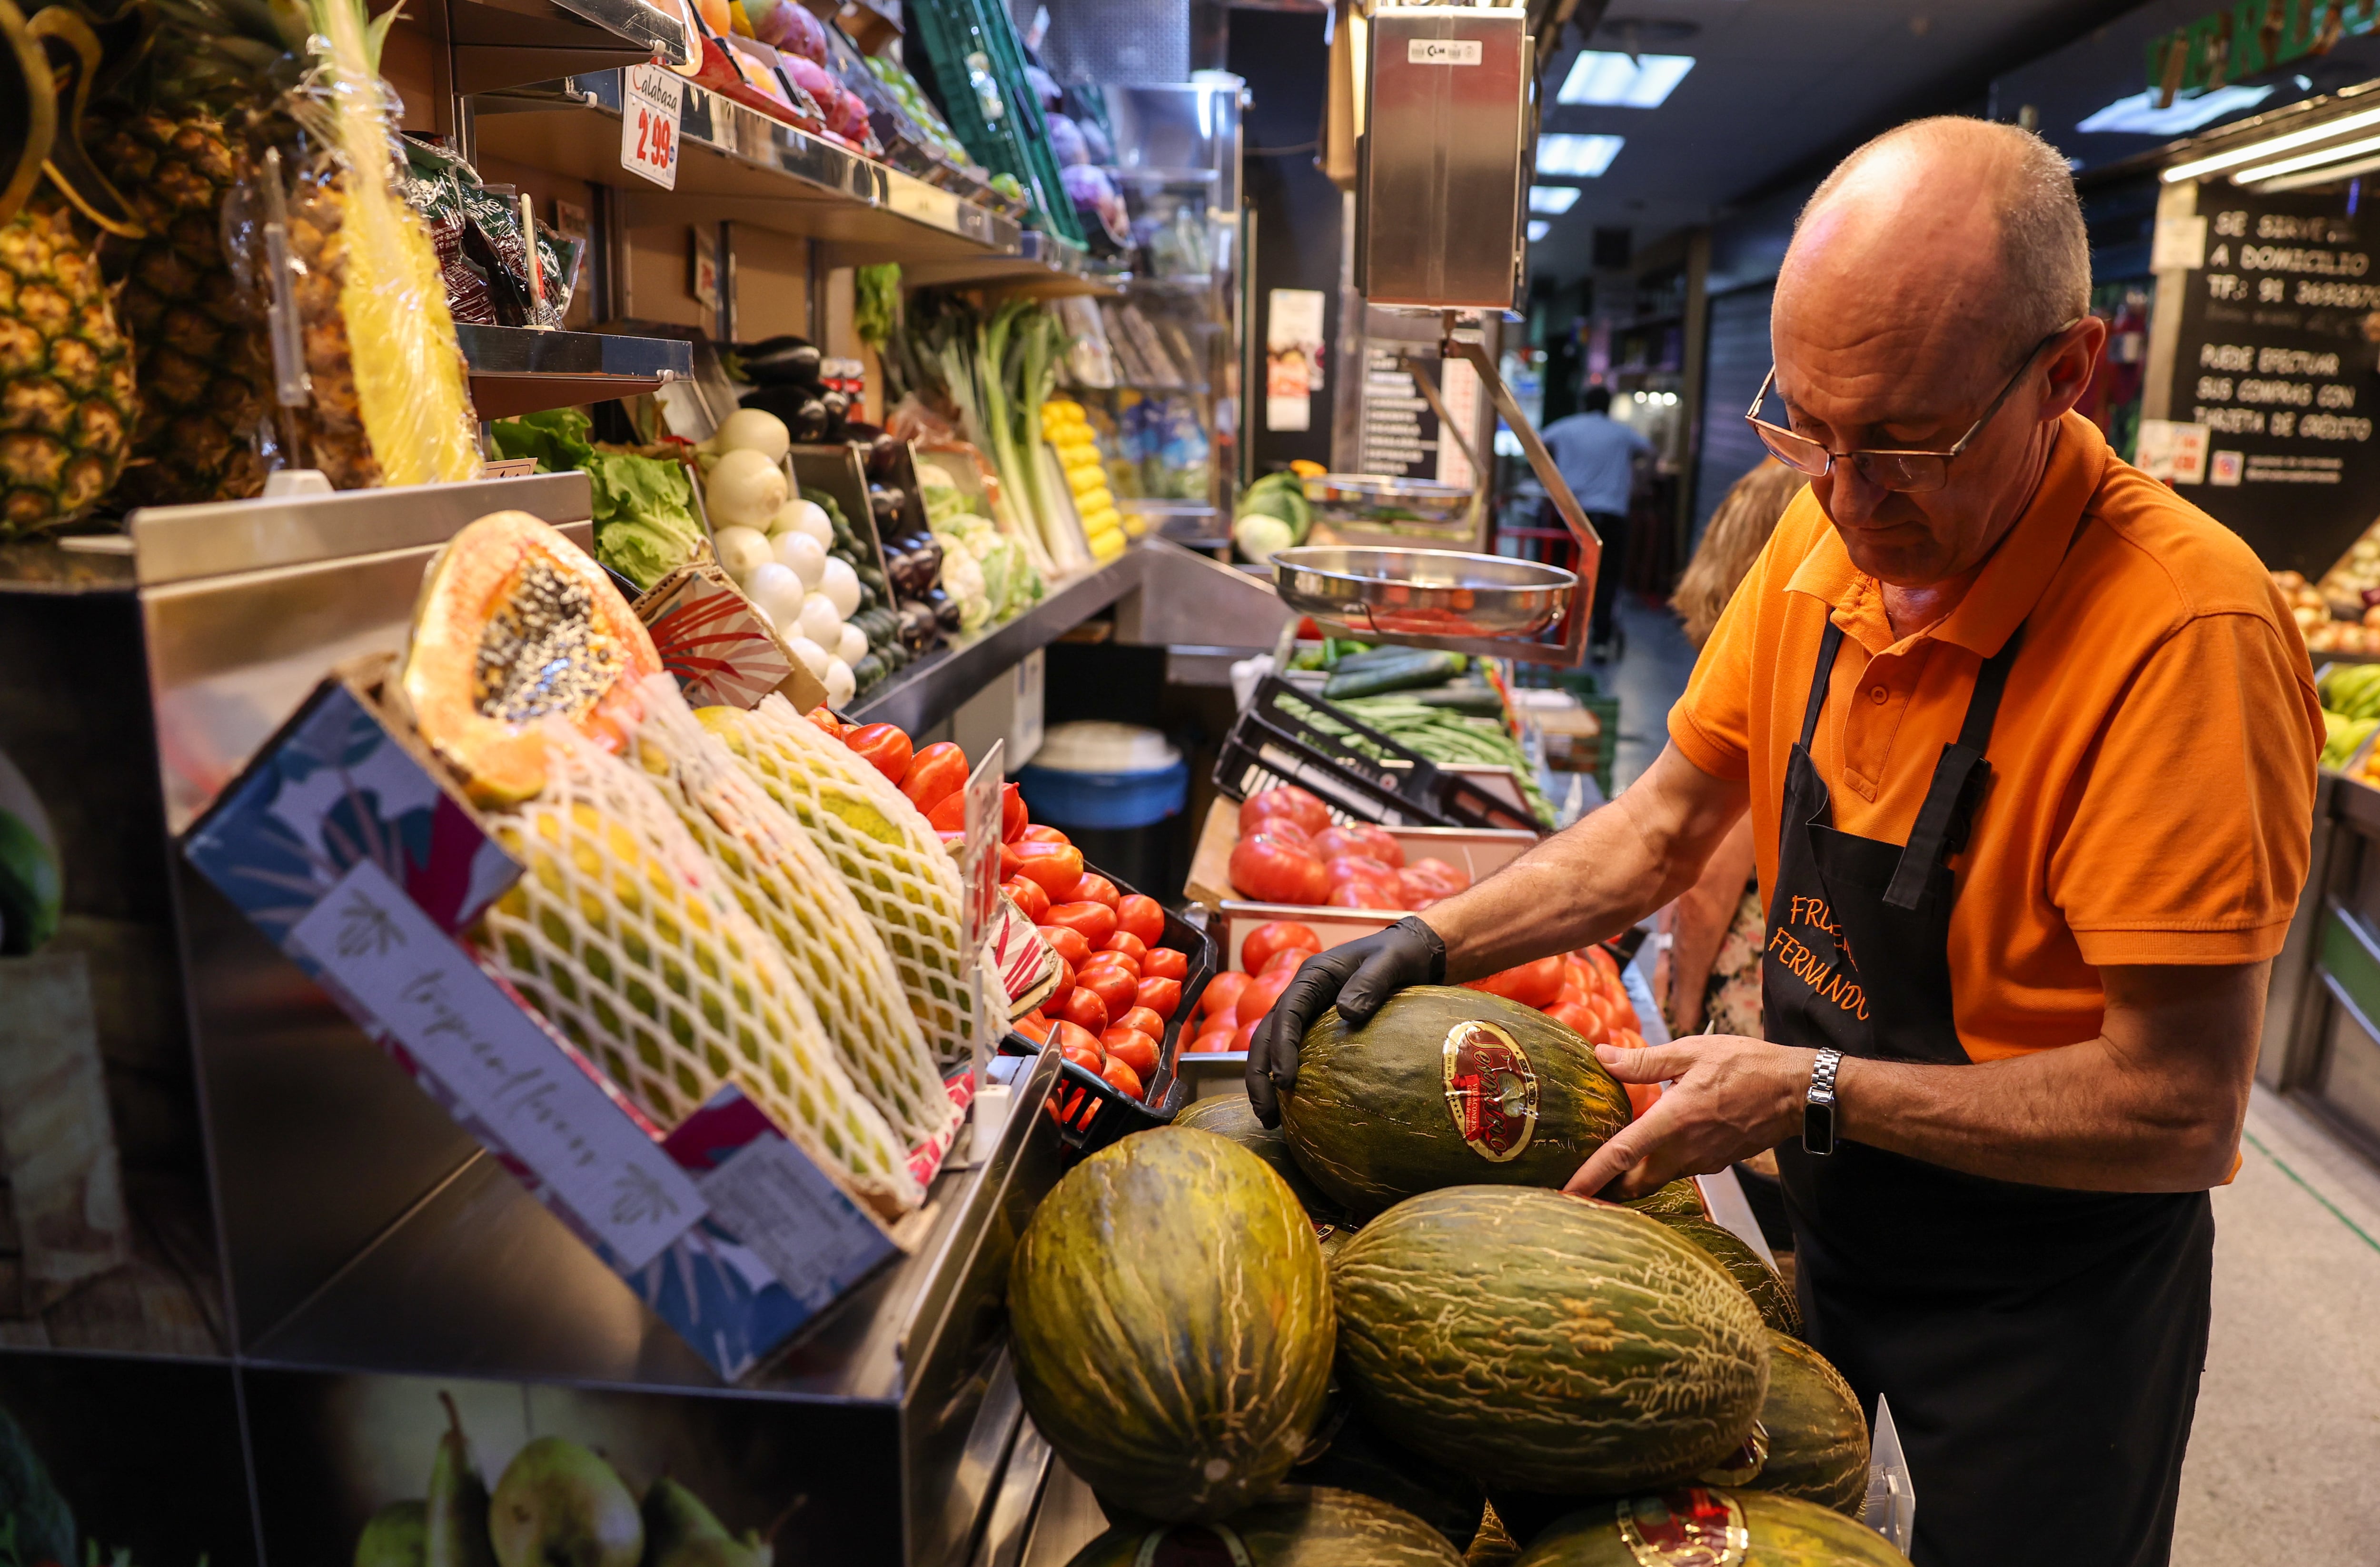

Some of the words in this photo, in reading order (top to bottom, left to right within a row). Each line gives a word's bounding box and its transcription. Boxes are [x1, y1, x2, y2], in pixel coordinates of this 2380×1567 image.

[633, 64, 678, 113] Calabaza
[2215, 211, 2248, 236] SE
[2211, 244, 2229, 266] A
[2240, 244, 2369, 276] DOMICILIO
[2201, 344, 2254, 371] PUEDE
[2258, 348, 2339, 376] EFECTUAR
[2196, 376, 2233, 400] SUS
[2237, 379, 2313, 406] COMPRAS
[2318, 385, 2355, 408] CON
[2271, 412, 2296, 437] DE
[1466, 1026, 1512, 1156] Serrano
